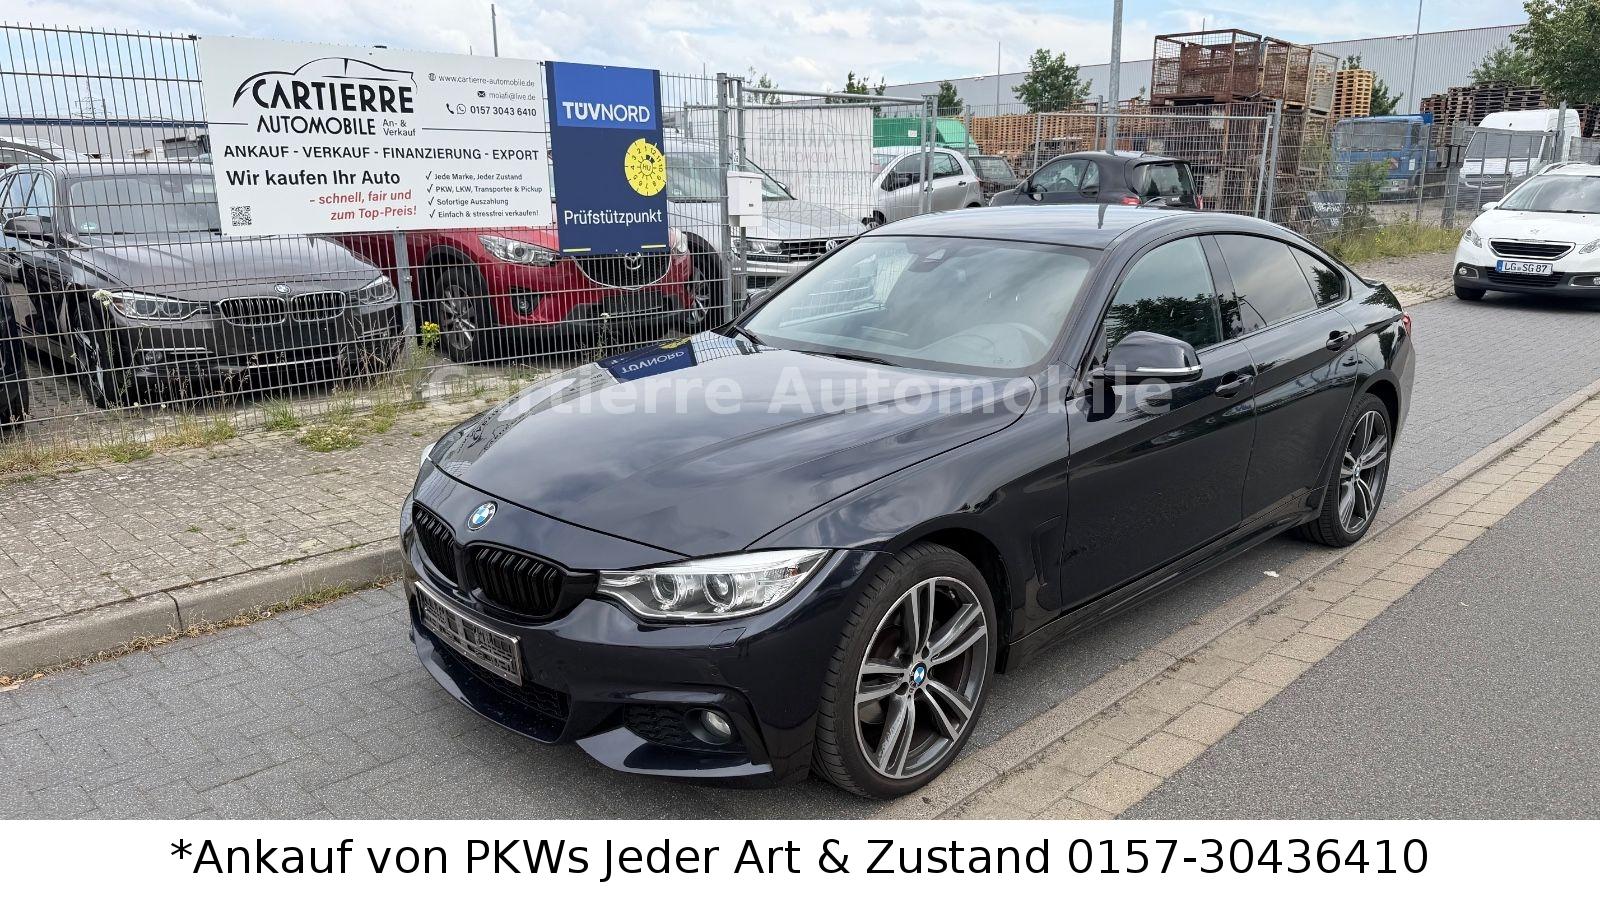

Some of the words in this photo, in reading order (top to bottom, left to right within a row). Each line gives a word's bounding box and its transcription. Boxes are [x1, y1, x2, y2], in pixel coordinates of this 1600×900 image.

[438, 74, 535, 87] www.cartierre-automobile.de
[252, 78, 414, 113] CARTIERRE
[470, 105, 490, 114] 0157
[493, 106, 515, 115] 3043
[517, 107, 537, 116] 6410
[256, 114, 376, 135] AUTOMOBILE
[382, 118, 398, 127] An-
[400, 119, 407, 127] &
[382, 127, 416, 137] Verkauf
[224, 145, 289, 158] ANKAUF
[302, 146, 370, 159] VERKAUF
[383, 147, 481, 160] FINANZIERUNG
[492, 149, 539, 160] EXPORT
[226, 170, 259, 186] Wir
[265, 170, 328, 186] kaufen
[333, 170, 356, 185] Ihr
[361, 170, 401, 185] Auto
[434, 173, 450, 181] Jede
[451, 173, 476, 182] Marke,
[477, 173, 494, 181] Jeder
[496, 173, 523, 181] Zustand
[435, 186, 455, 194] PKW,
[456, 186, 473, 194] LKW,
[474, 185, 513, 195] Transporter
[521, 186, 543, 195] Pickup
[318, 191, 365, 205] schnell,
[368, 189, 388, 202] fair
[390, 189, 411, 201] und
[436, 198, 469, 207] Sofortige
[470, 198, 509, 207] Auszahlung
[330, 211, 355, 221] zum
[358, 205, 417, 220] Top-Preis!
[438, 210, 464, 219] Einfach
[465, 210, 471, 218] &
[472, 209, 504, 218] stressfrei
[505, 207, 539, 217] verkaufen!
[564, 208, 663, 227] Prüfstützpunkt
[1504, 262, 1517, 271] LG
[1521, 263, 1534, 272] SG
[1535, 264, 1547, 273] 87
